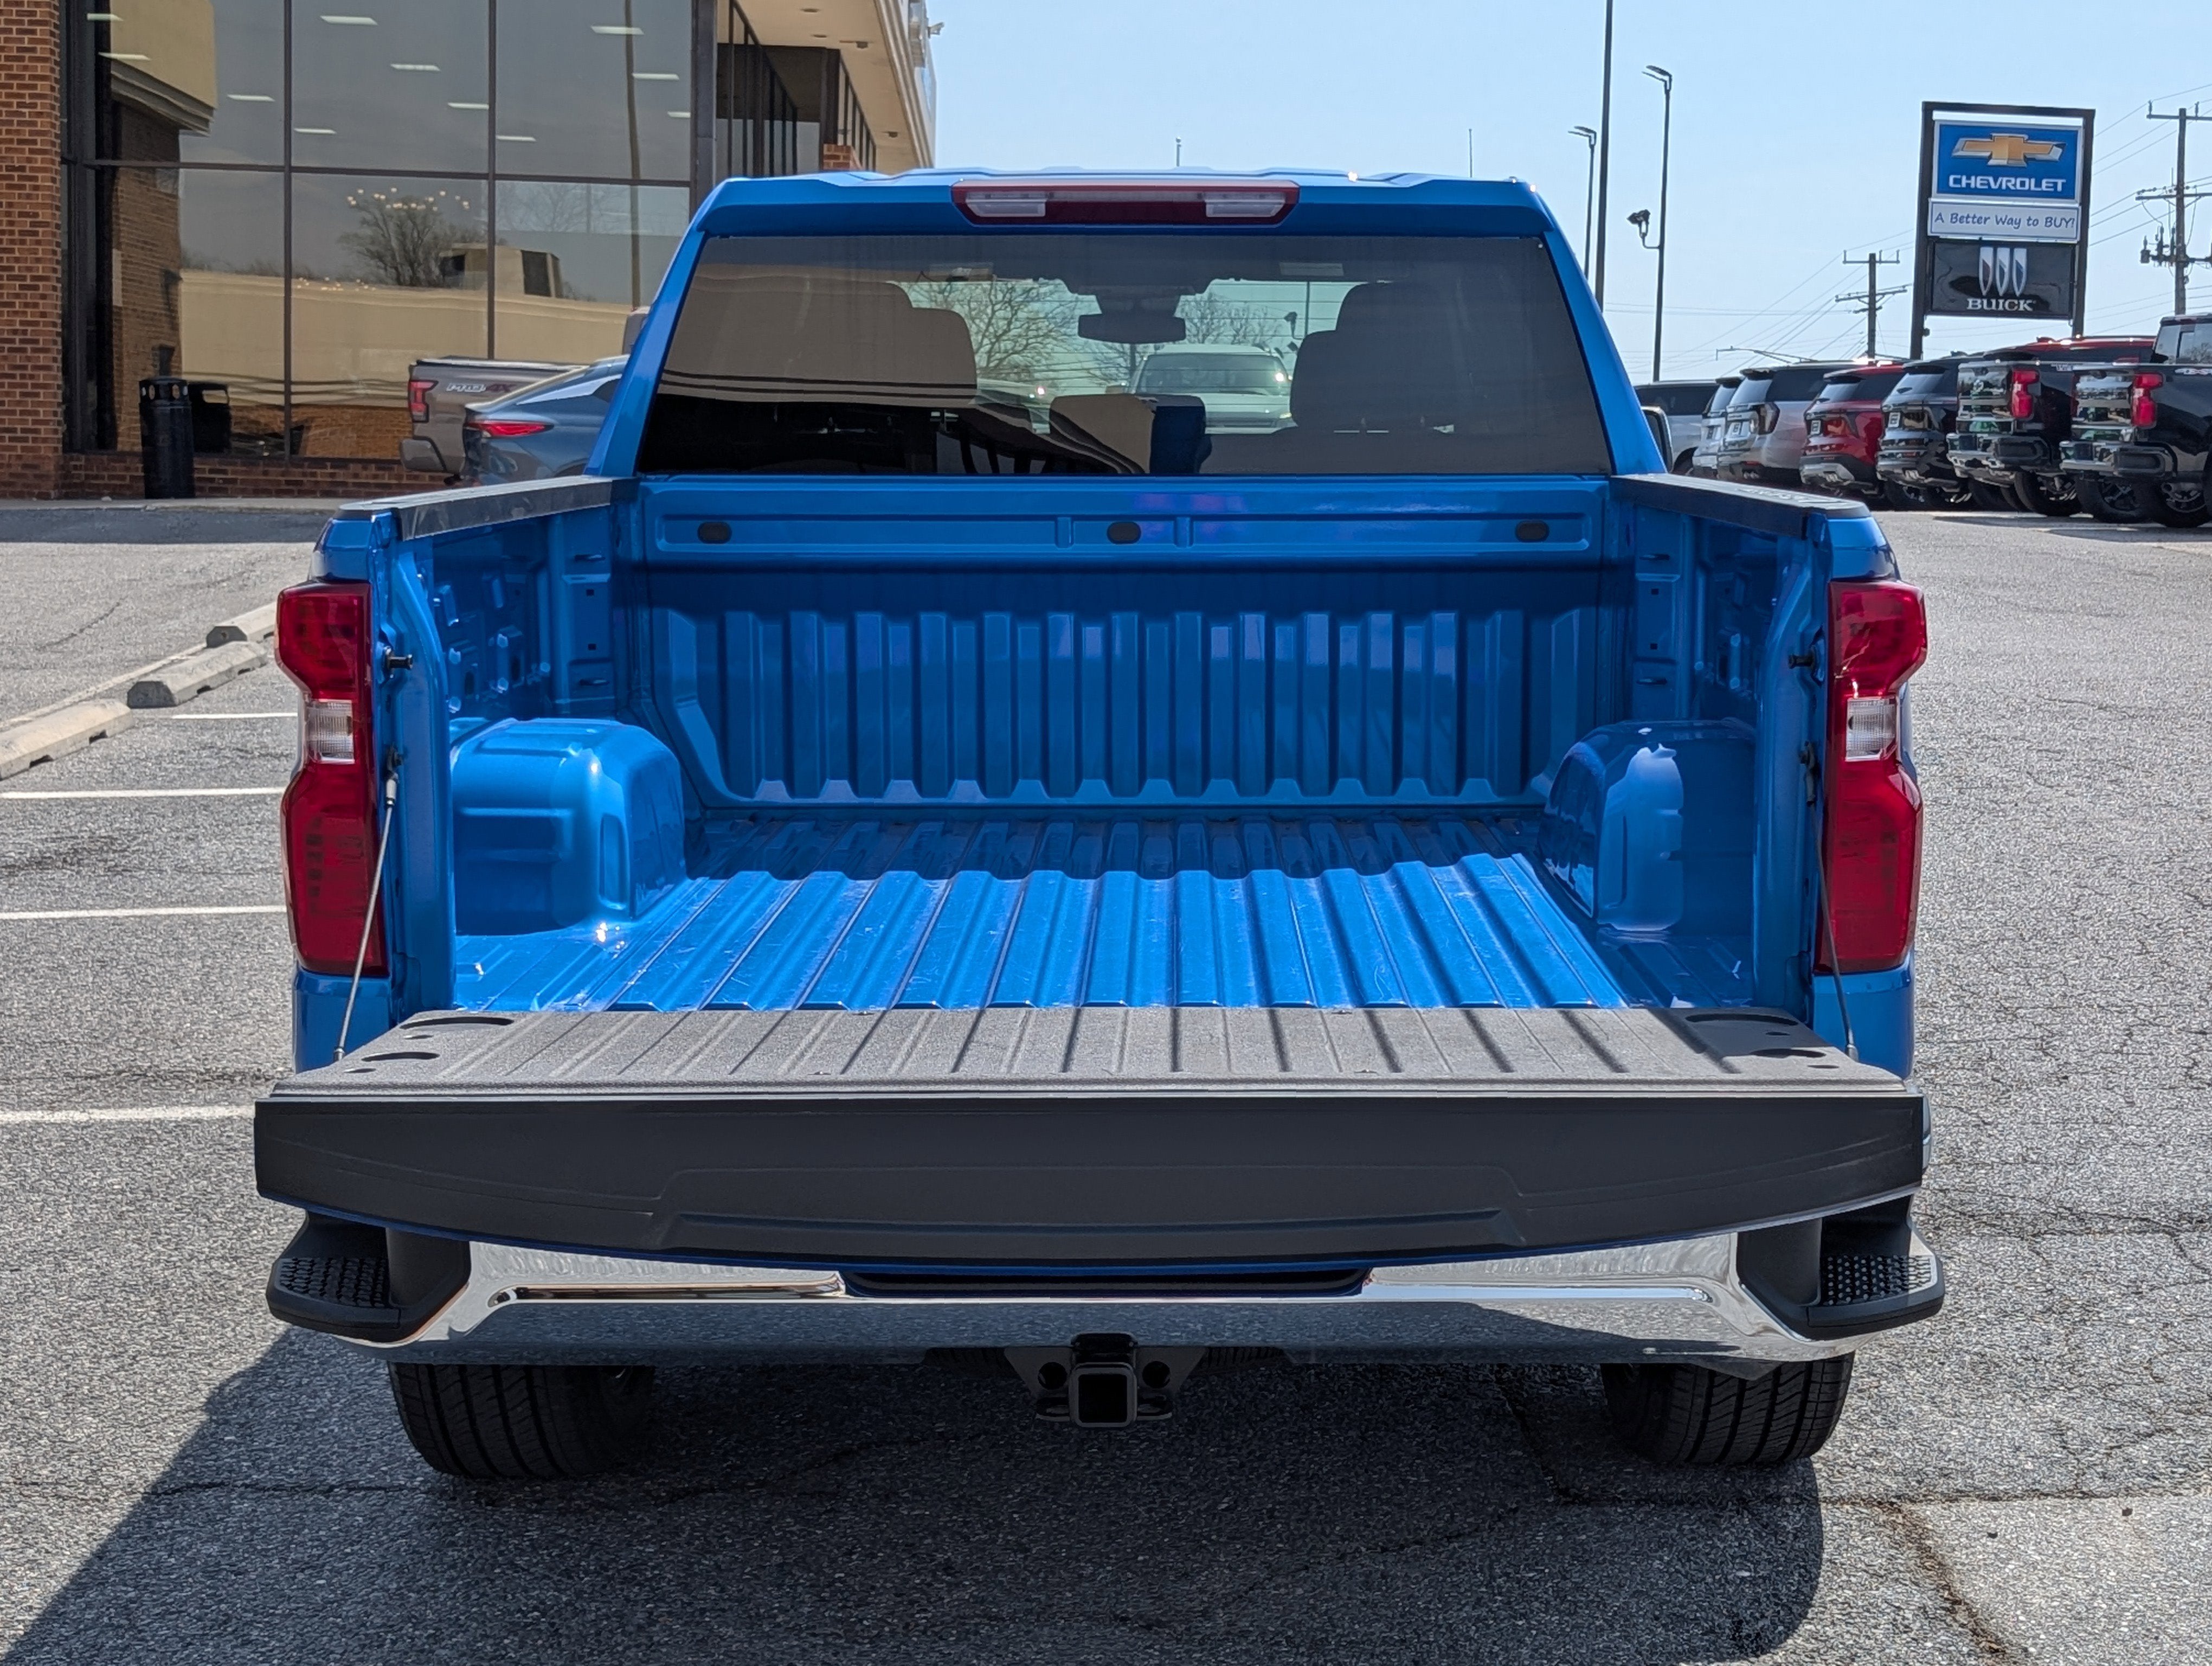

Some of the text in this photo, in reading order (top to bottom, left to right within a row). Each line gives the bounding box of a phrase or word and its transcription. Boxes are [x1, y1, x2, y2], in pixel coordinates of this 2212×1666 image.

[1949, 175, 2066, 192] CHEVROLET
[1934, 212, 2075, 229] A Better Way to BUY!
[1966, 298, 2033, 311] BUICK
